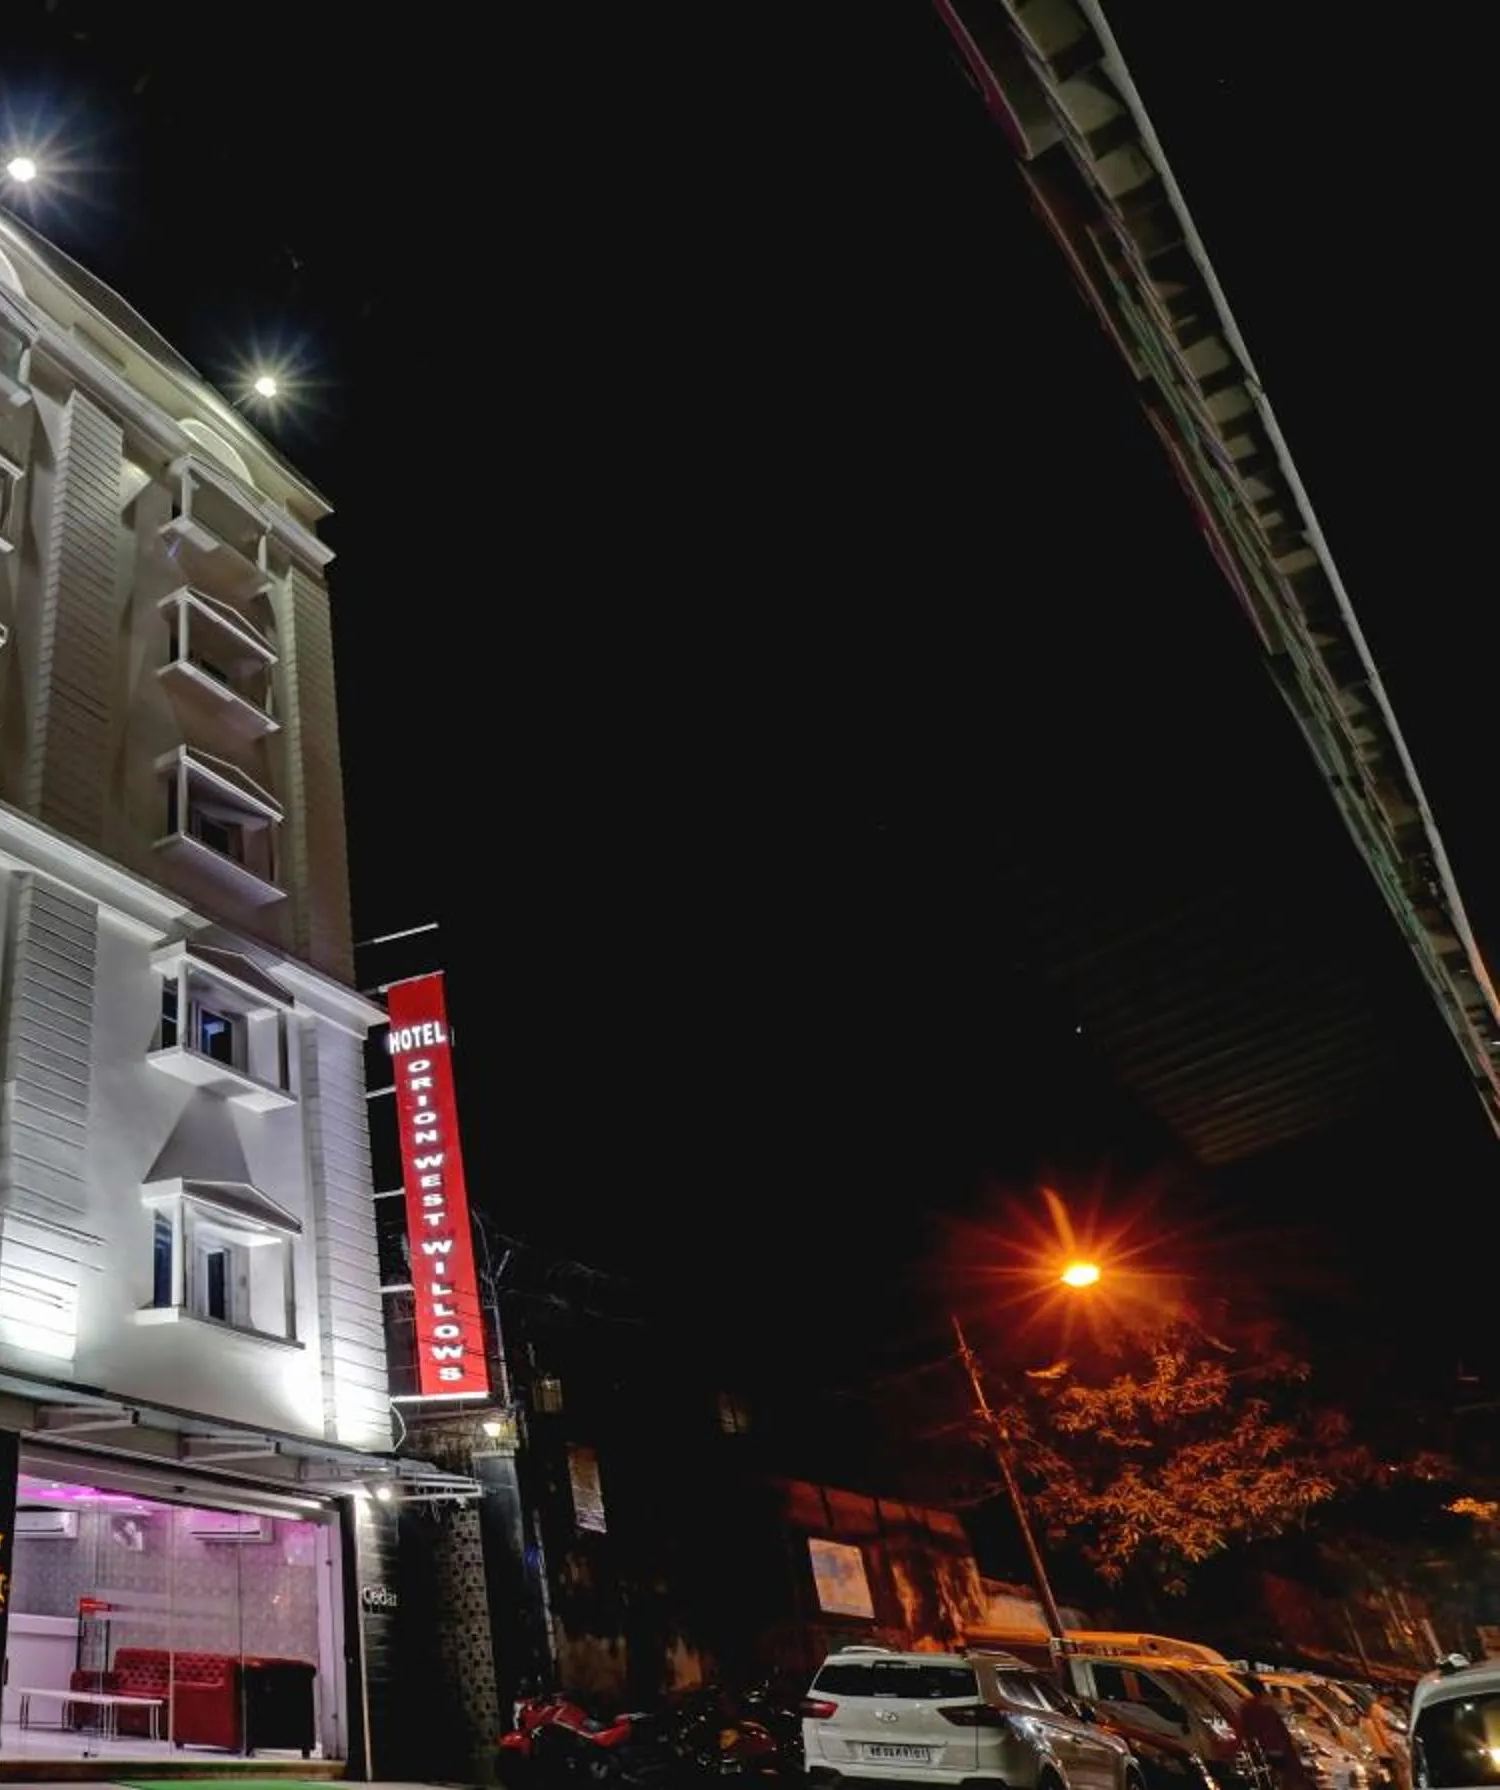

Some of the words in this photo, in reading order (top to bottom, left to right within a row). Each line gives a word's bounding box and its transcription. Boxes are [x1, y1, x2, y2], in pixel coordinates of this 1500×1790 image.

[389, 1021, 447, 1055] HOTEL
[408, 1060, 438, 1144] ORION
[413, 1153, 445, 1226] WEST
[421, 1240, 464, 1381] WILLOWS
